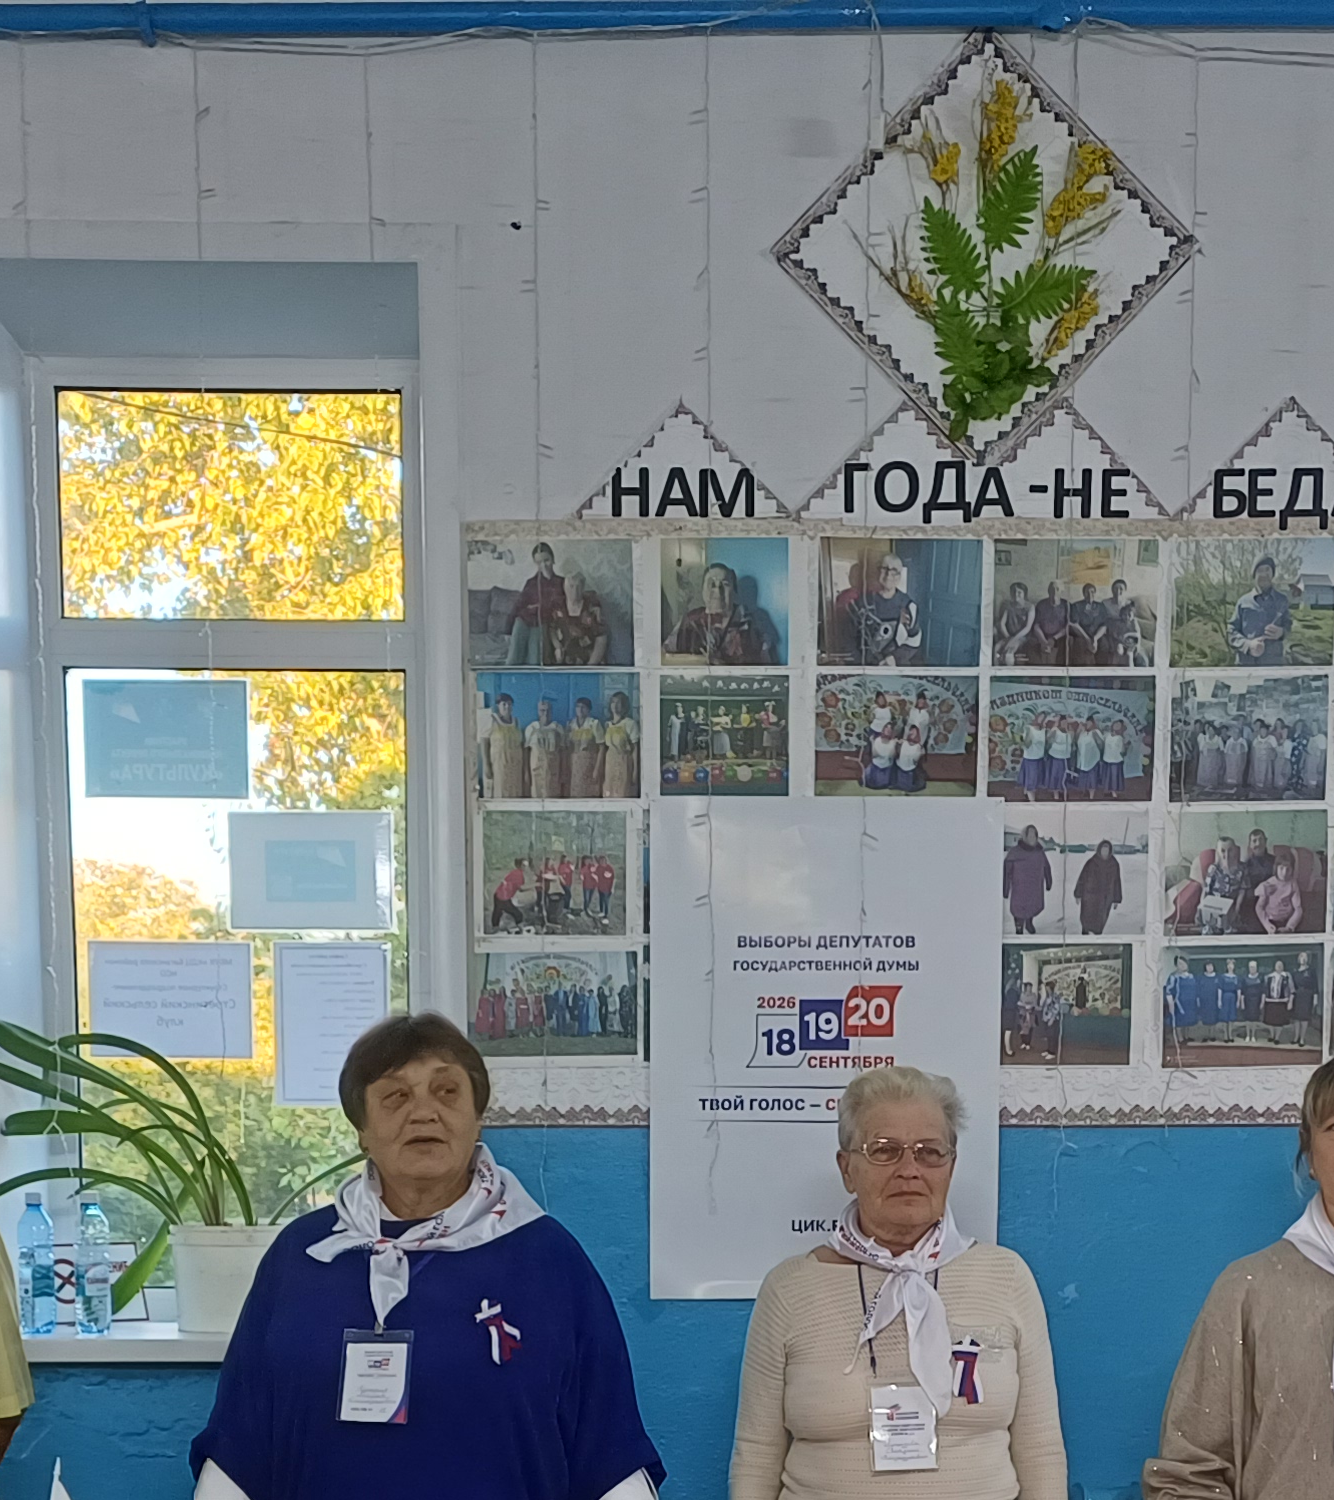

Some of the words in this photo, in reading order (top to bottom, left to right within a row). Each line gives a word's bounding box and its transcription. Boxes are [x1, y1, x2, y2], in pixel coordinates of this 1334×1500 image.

[612, 467, 755, 518] НАМ
[843, 461, 1015, 524] ГОДА
[737, 935, 811, 949] ВЫБОРЫ
[816, 935, 916, 950] ДЕПУТАТОВ
[733, 957, 872, 972] ГОСУДАРСТВЕННОЙ
[876, 960, 919, 973] ДУМЫ
[756, 996, 797, 1010] 2026
[761, 1028, 797, 1057] 18
[803, 1011, 840, 1041] 19
[847, 997, 891, 1027] 20
[807, 1055, 895, 1069] СЕНТЯБРЯ
[699, 1095, 745, 1112] ТВОЙ
[749, 1098, 806, 1112] ГОЛОС
